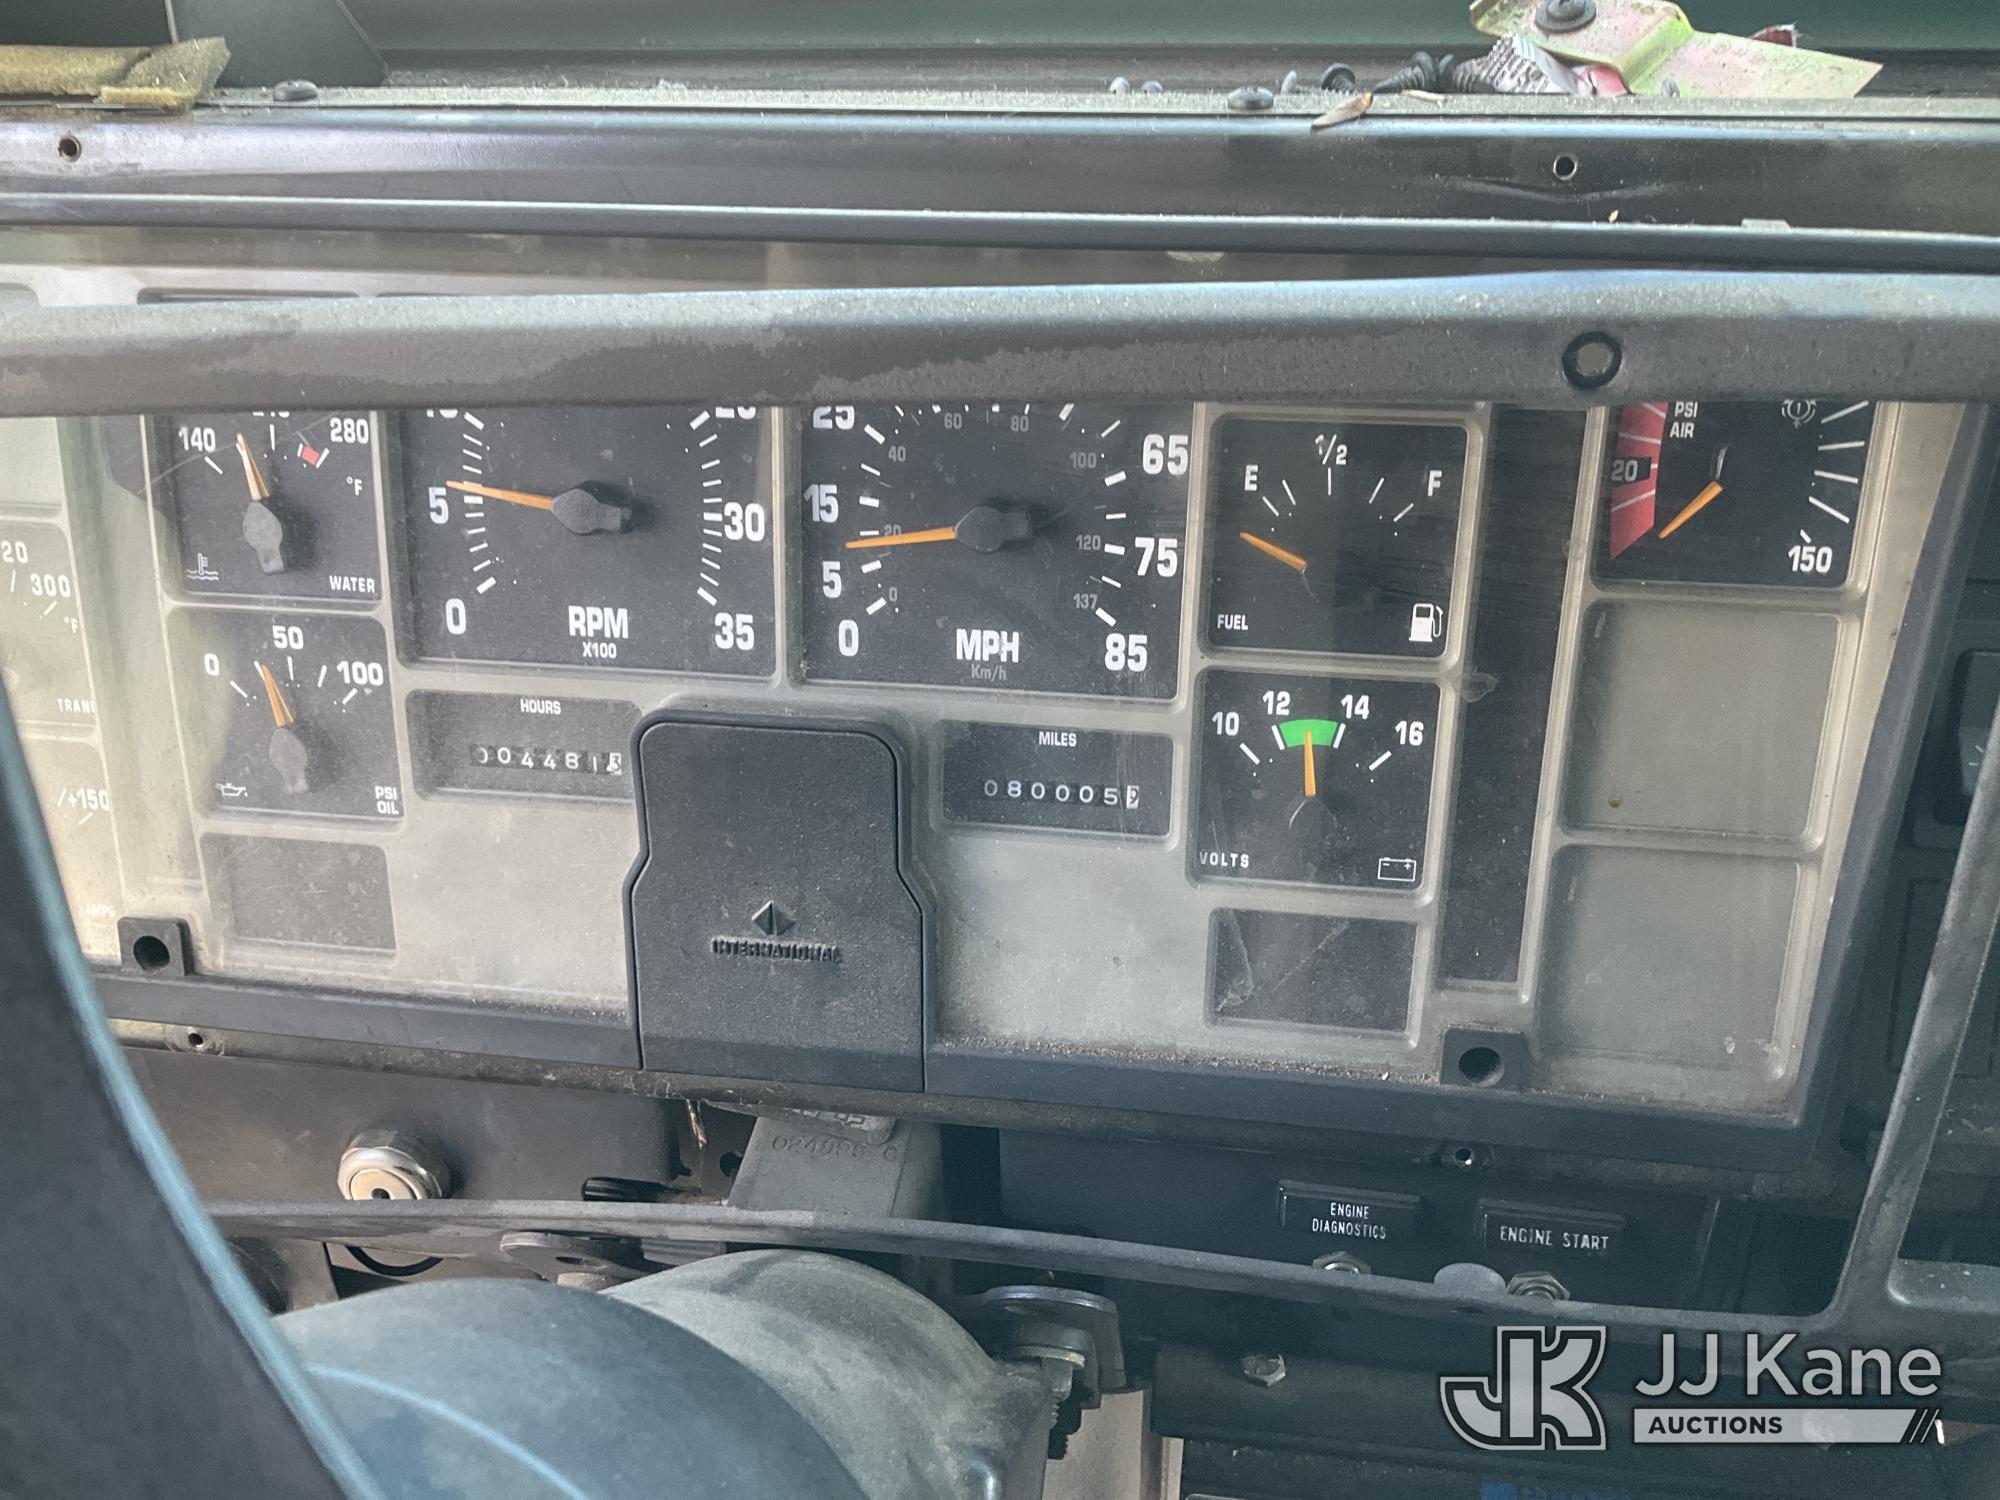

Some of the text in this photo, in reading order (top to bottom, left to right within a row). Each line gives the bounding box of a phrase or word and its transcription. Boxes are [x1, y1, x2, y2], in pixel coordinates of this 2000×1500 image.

[943, 413, 963, 430] 60
[1674, 401, 1699, 418] PSI
[329, 417, 369, 444] 280
[1010, 415, 1030, 432] 80
[1669, 421, 1695, 439] AIR
[178, 427, 216, 452] 140
[888, 445, 907, 463] 40
[1069, 451, 1097, 470] 100
[1142, 434, 1189, 476] 65
[1244, 464, 1259, 491] E
[1427, 469, 1443, 497] F
[1611, 459, 1639, 482] 20
[428, 486, 449, 524] 5
[803, 484, 840, 523] 15
[723, 502, 766, 542] 30
[1075, 534, 1101, 552] 120
[1134, 536, 1178, 577] 75
[1787, 545, 1833, 573] 150
[30, 573, 71, 599] 300
[328, 575, 376, 593] WATER
[822, 560, 842, 599] 5
[1073, 593, 1099, 610] 137
[445, 598, 467, 635] 0
[568, 605, 629, 639] RPM
[1216, 614, 1249, 631] FUEL
[272, 625, 304, 650] 50
[714, 612, 755, 651] 35
[837, 619, 860, 657] 0
[582, 642, 617, 659] X100
[955, 629, 1020, 663] MPH
[1104, 633, 1148, 672] 85
[203, 653, 220, 676] 0
[336, 660, 384, 686] 100
[970, 664, 1007, 682] Km/h
[519, 698, 562, 715] HOURS
[1262, 690, 1291, 715] 12
[1340, 694, 1370, 720] 14
[1211, 711, 1240, 736] 10
[1394, 720, 1425, 746] 16
[1038, 731, 1077, 748] MILES
[375, 786, 398, 800] PSI
[377, 801, 399, 815] OIL
[1199, 851, 1250, 869] VOLTS
[711, 936, 843, 963] INTERNATIONAL
[1329, 1202, 1370, 1220] ENGINE
[1311, 1218, 1387, 1240] DIAGNOSTICS
[1500, 1225, 1609, 1250] ENGINE START
